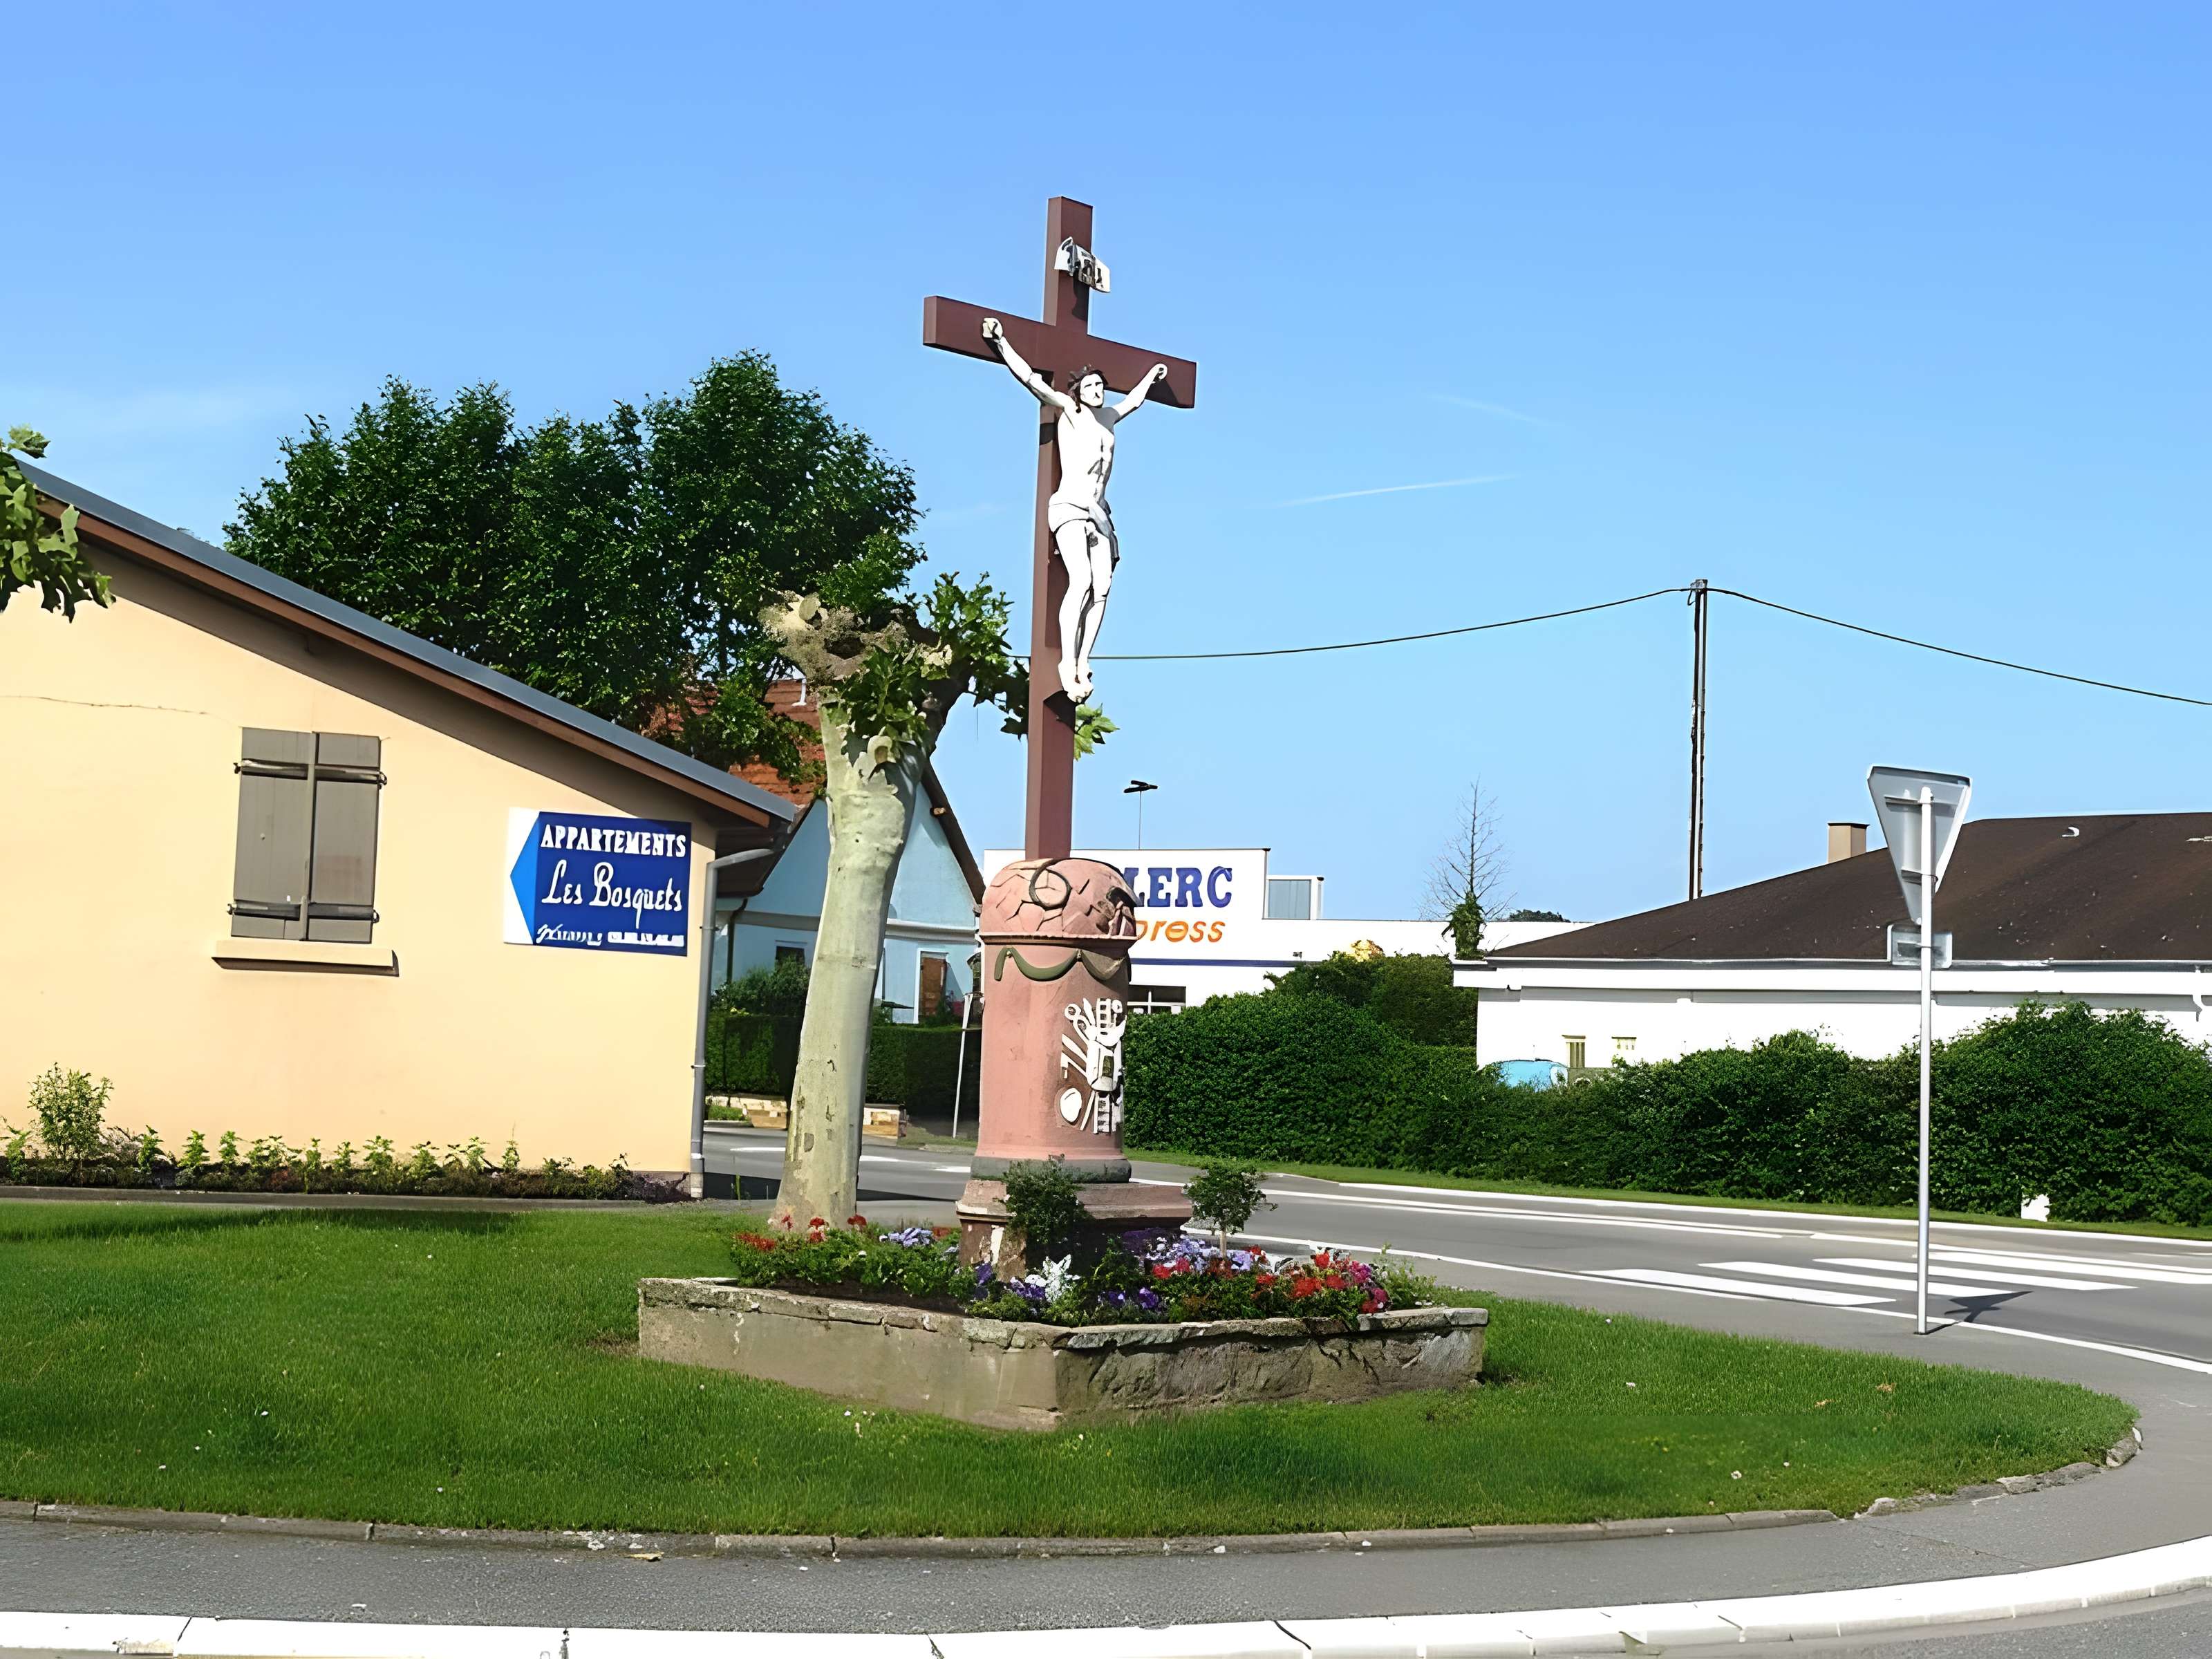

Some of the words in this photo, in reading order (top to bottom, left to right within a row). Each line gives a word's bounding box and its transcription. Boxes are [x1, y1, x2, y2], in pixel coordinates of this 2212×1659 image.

[541, 824, 686, 857] APPARTEMENTS
[541, 859, 583, 904] Les
[589, 861, 682, 929] Bosquets
